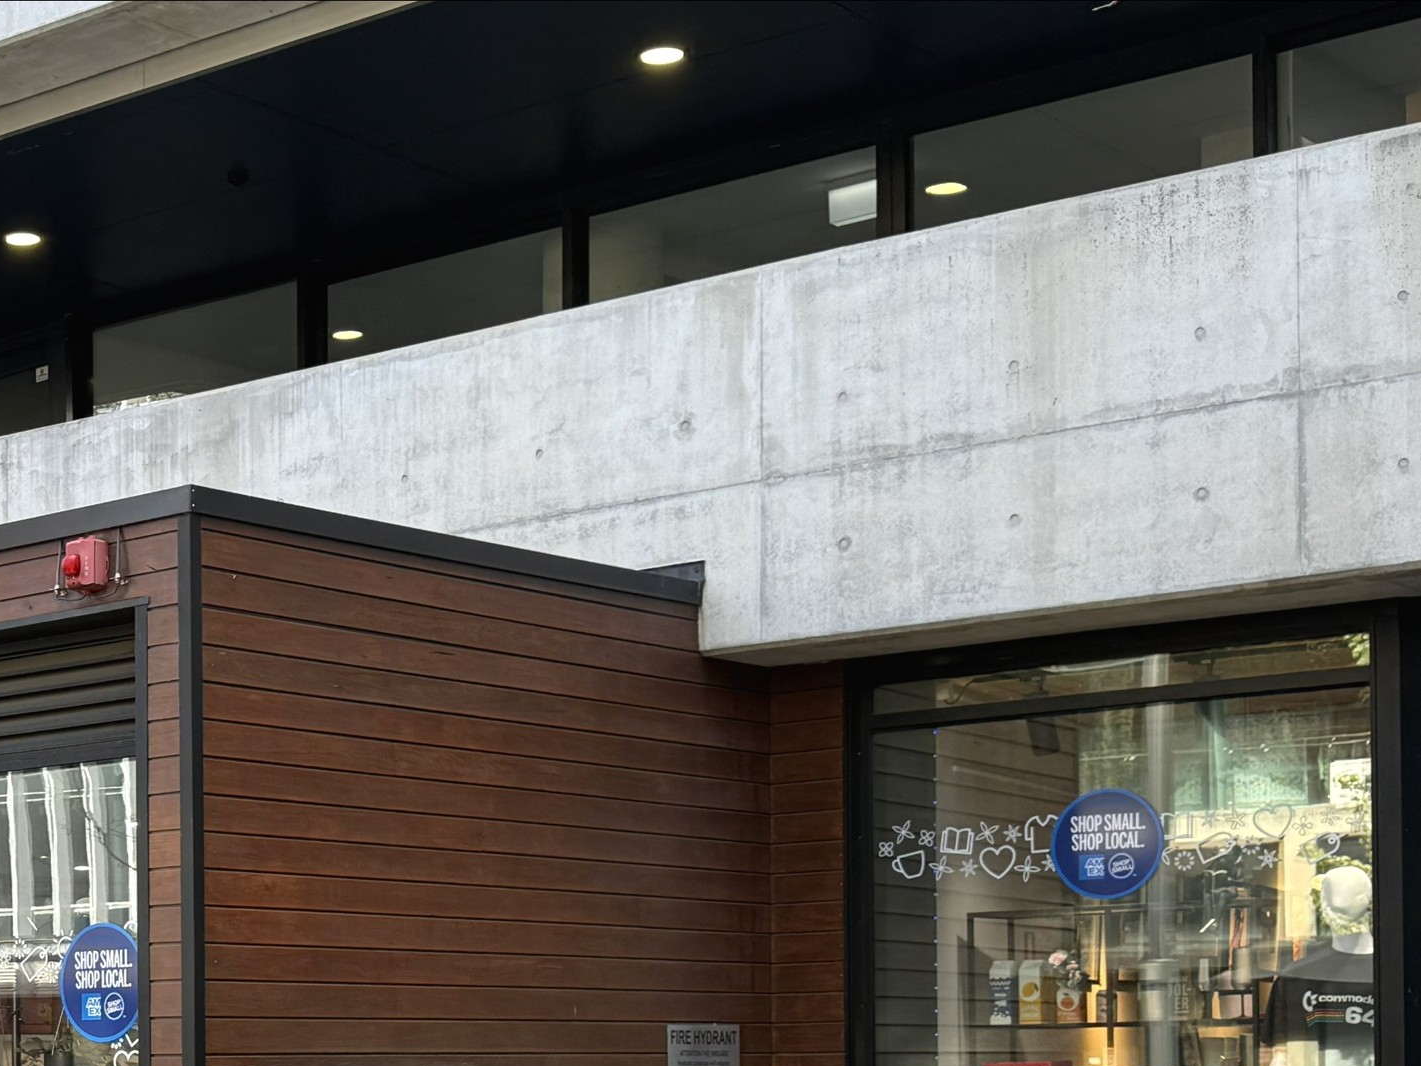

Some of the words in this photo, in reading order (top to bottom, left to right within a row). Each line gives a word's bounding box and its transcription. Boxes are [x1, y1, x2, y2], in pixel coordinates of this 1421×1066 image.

[1070, 815, 1102, 833] SHOP
[1104, 813, 1146, 831] SMALL.
[1071, 833, 1103, 851] SHOP
[1105, 831, 1145, 850] LOCAL.
[74, 951, 99, 970] SHOP
[100, 949, 133, 968] SMALL.
[75, 970, 100, 989] SHOP
[101, 969, 132, 988] LOCAL.
[671, 1030, 692, 1045] FIRE
[694, 1030, 737, 1046] HYDRANT
